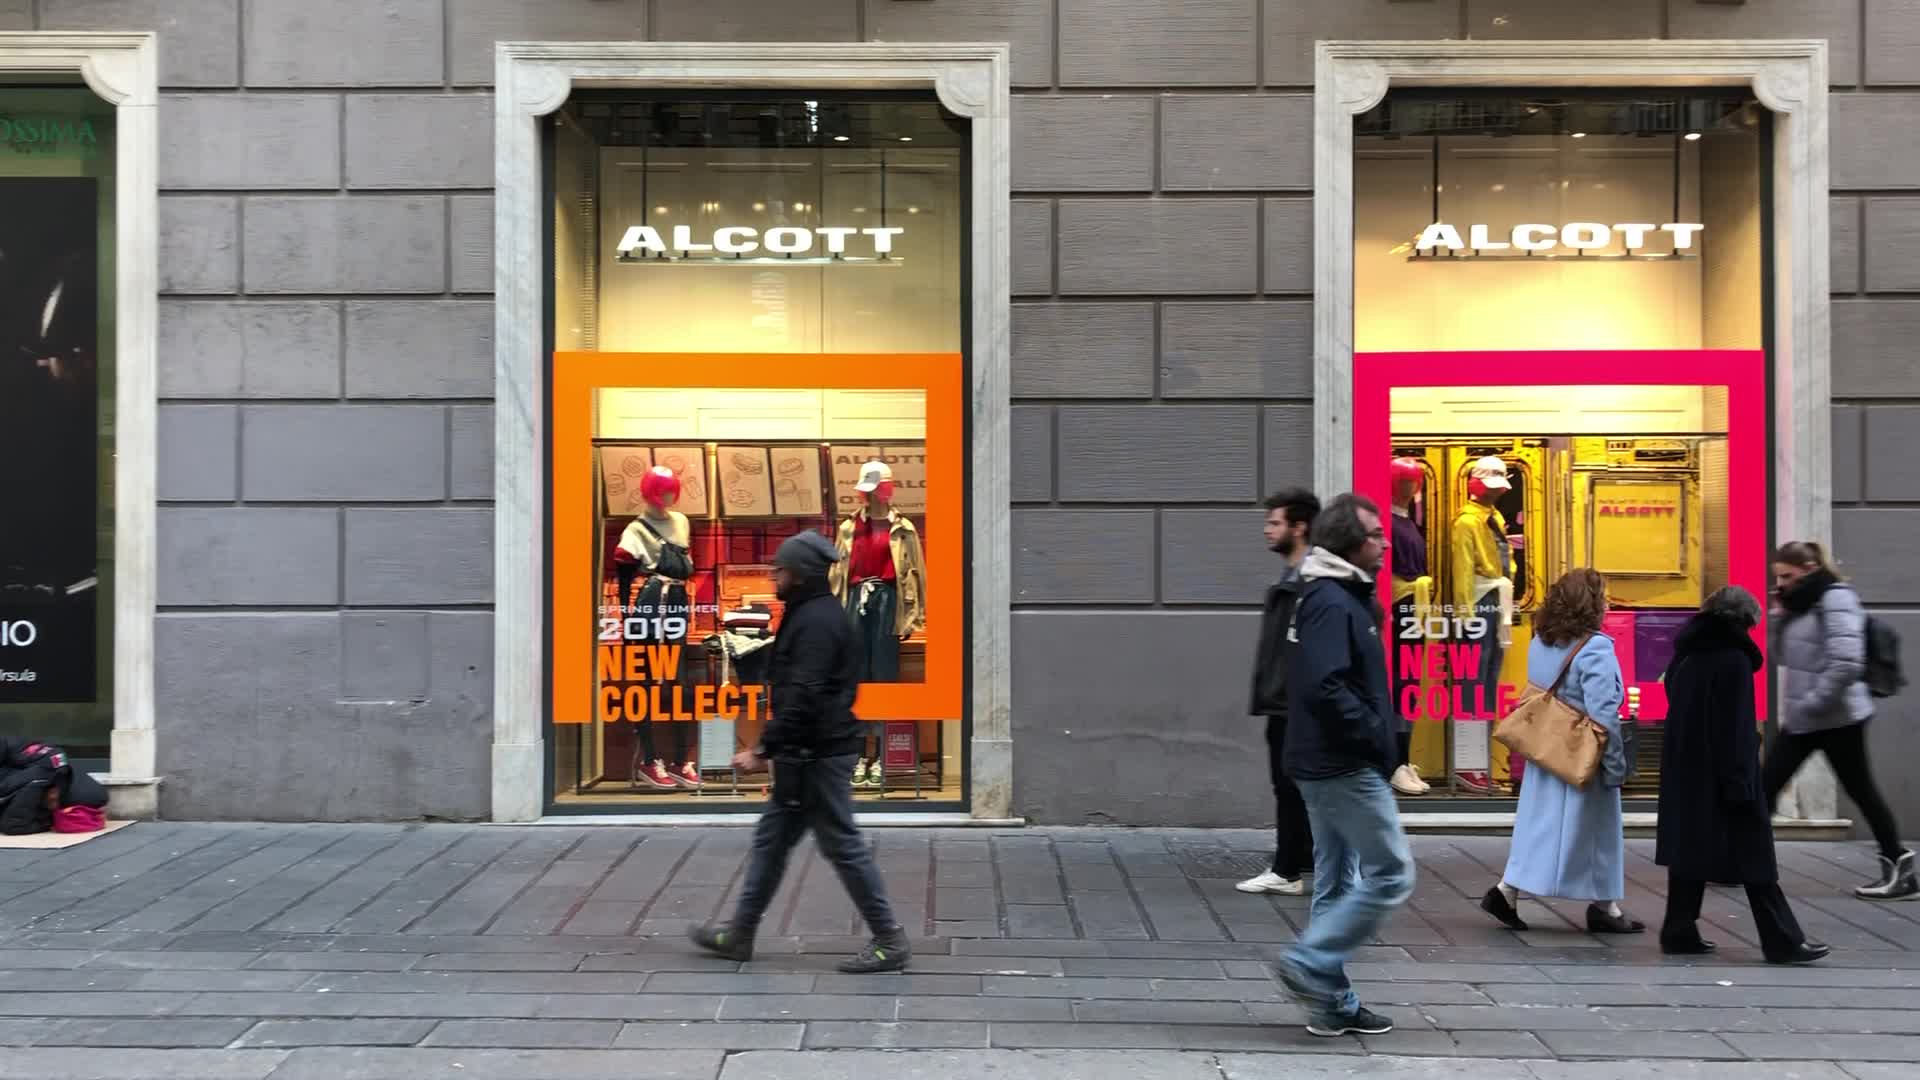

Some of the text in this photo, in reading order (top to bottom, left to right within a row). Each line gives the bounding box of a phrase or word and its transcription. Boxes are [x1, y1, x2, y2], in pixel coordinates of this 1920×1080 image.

[616, 225, 904, 252] ALCOTT
[1415, 222, 1704, 250] ALCOTT
[598, 604, 719, 614] SPRING SUMMER
[599, 617, 686, 640] 2019
[1400, 616, 1488, 639] 2019
[600, 644, 681, 681] NEW
[1400, 643, 1482, 680] NEW
